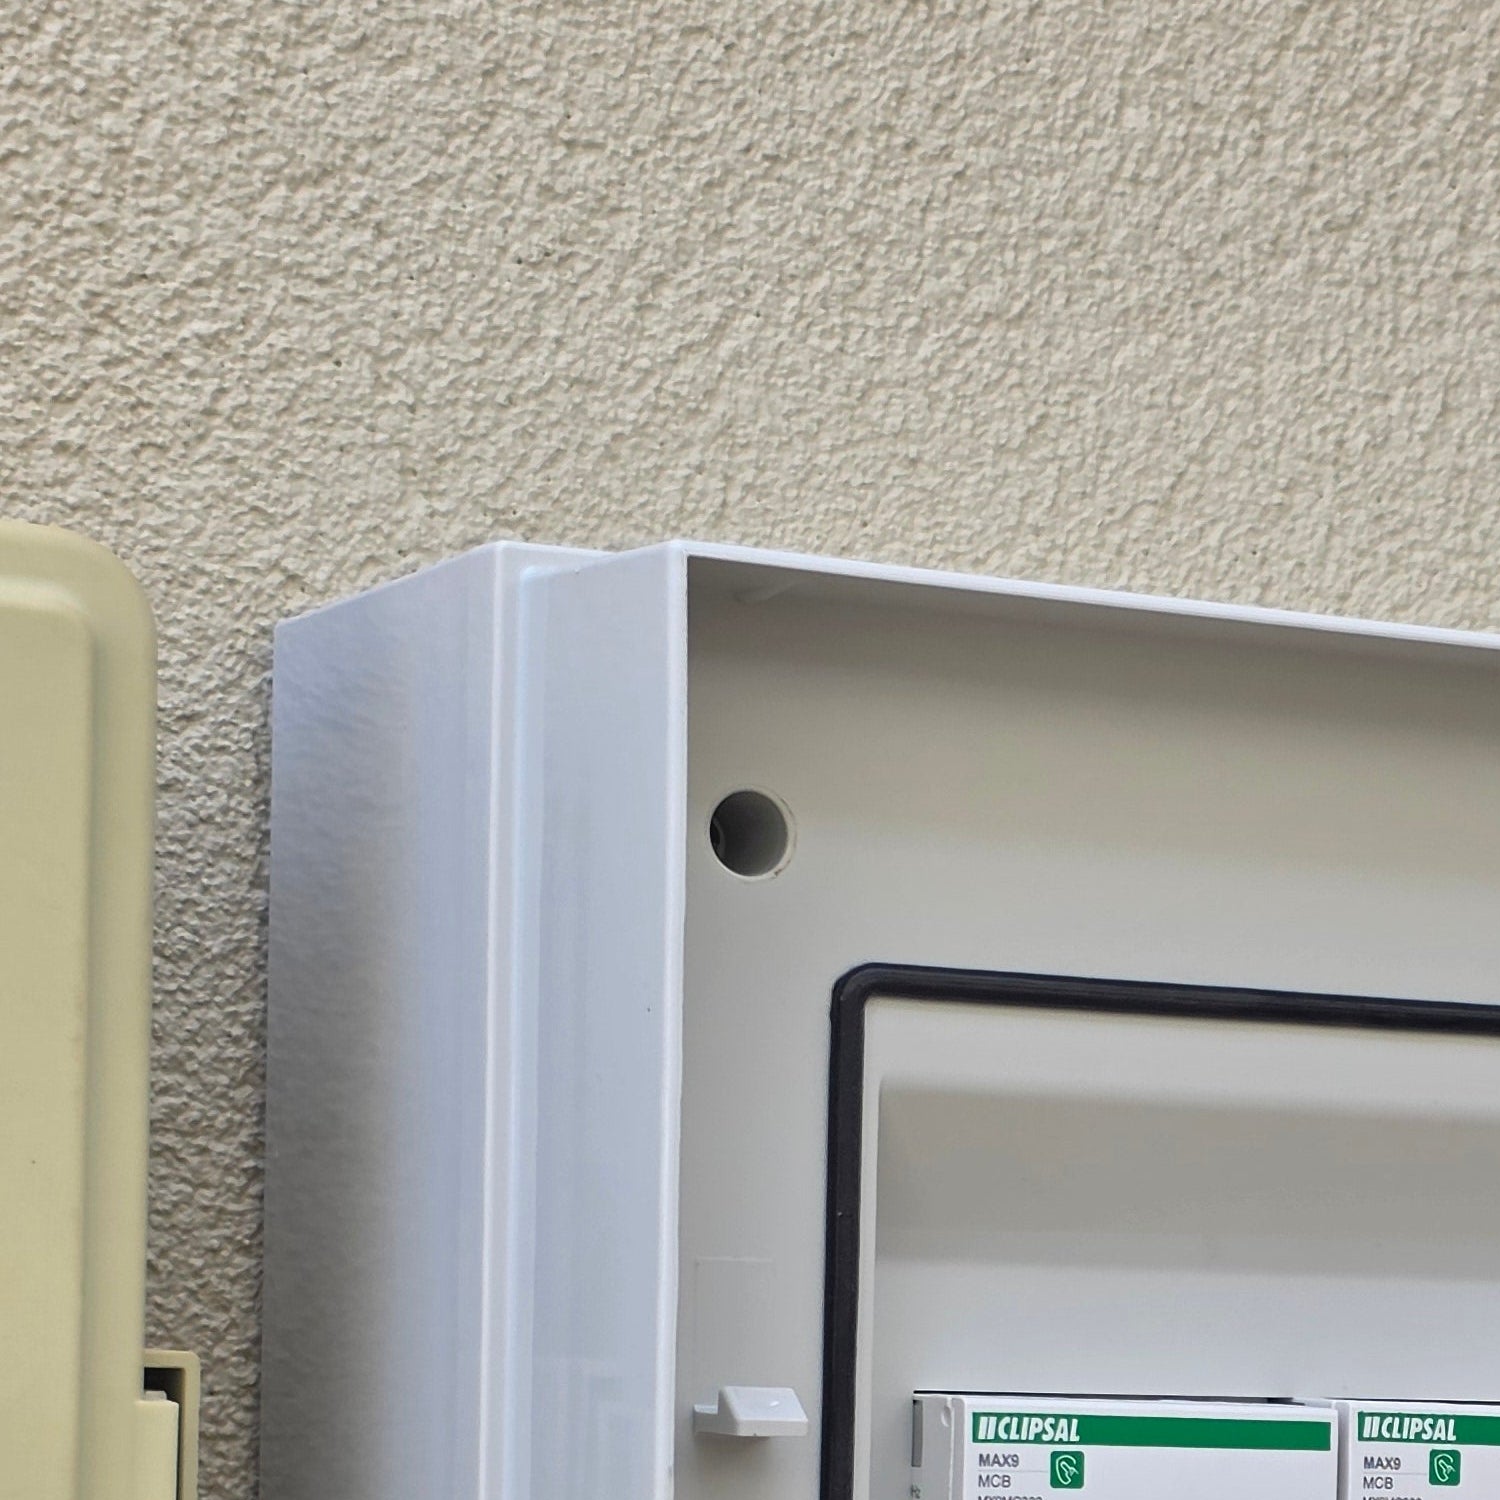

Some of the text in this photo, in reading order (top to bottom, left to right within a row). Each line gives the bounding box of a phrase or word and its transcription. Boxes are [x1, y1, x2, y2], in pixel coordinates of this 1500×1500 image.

[978, 1453, 1020, 1468] MAX9
[1363, 1456, 1402, 1470] MAX9
[977, 1474, 1012, 1488] MCB
[1362, 1476, 1394, 1490] MCB
